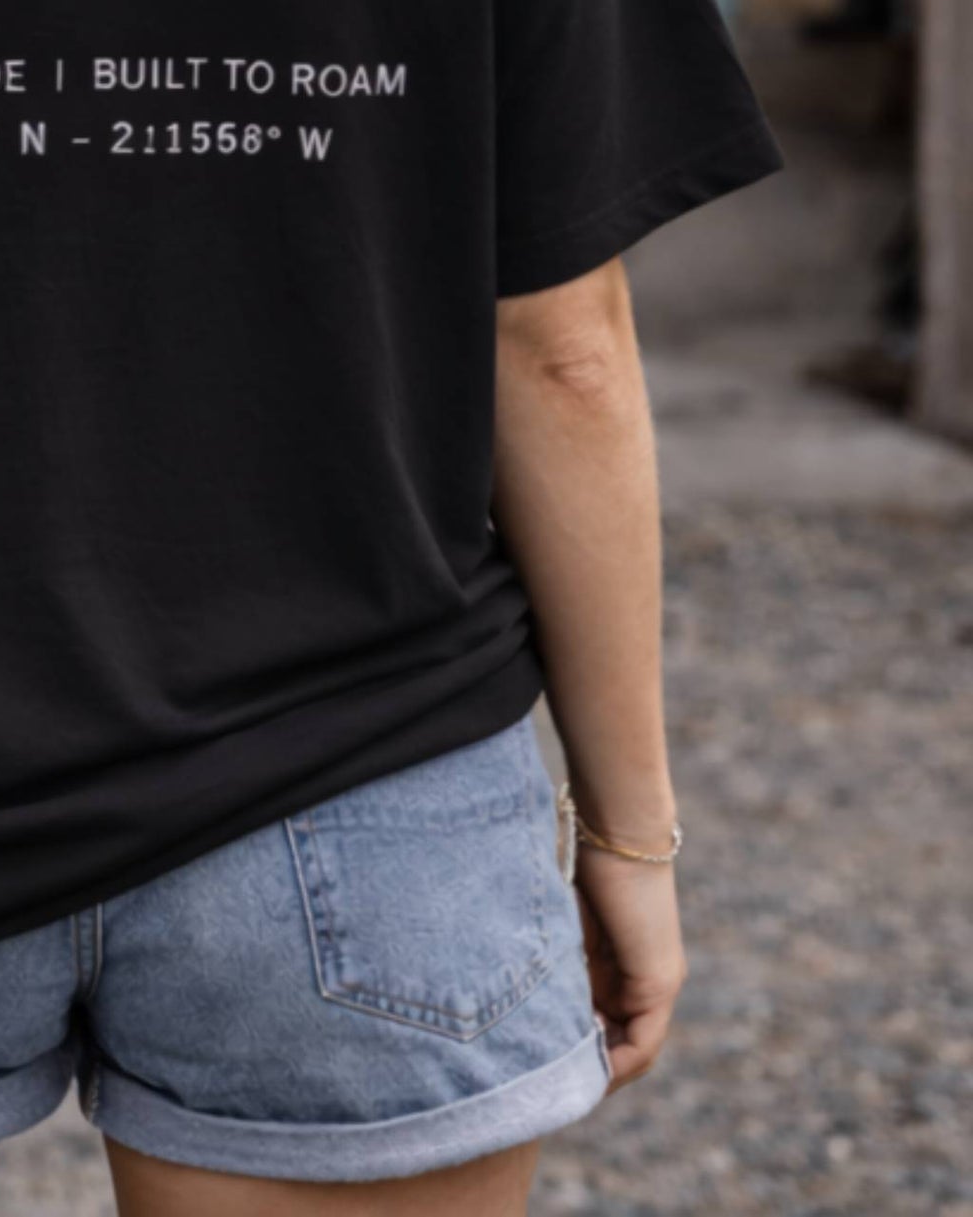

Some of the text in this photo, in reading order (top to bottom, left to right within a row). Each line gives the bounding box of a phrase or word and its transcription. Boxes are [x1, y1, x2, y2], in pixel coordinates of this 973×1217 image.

[94, 57, 208, 90] BUILT
[223, 58, 275, 95] TO
[291, 63, 407, 97] ROAM
[20, 121, 46, 155] N
[298, 126, 333, 161] W
